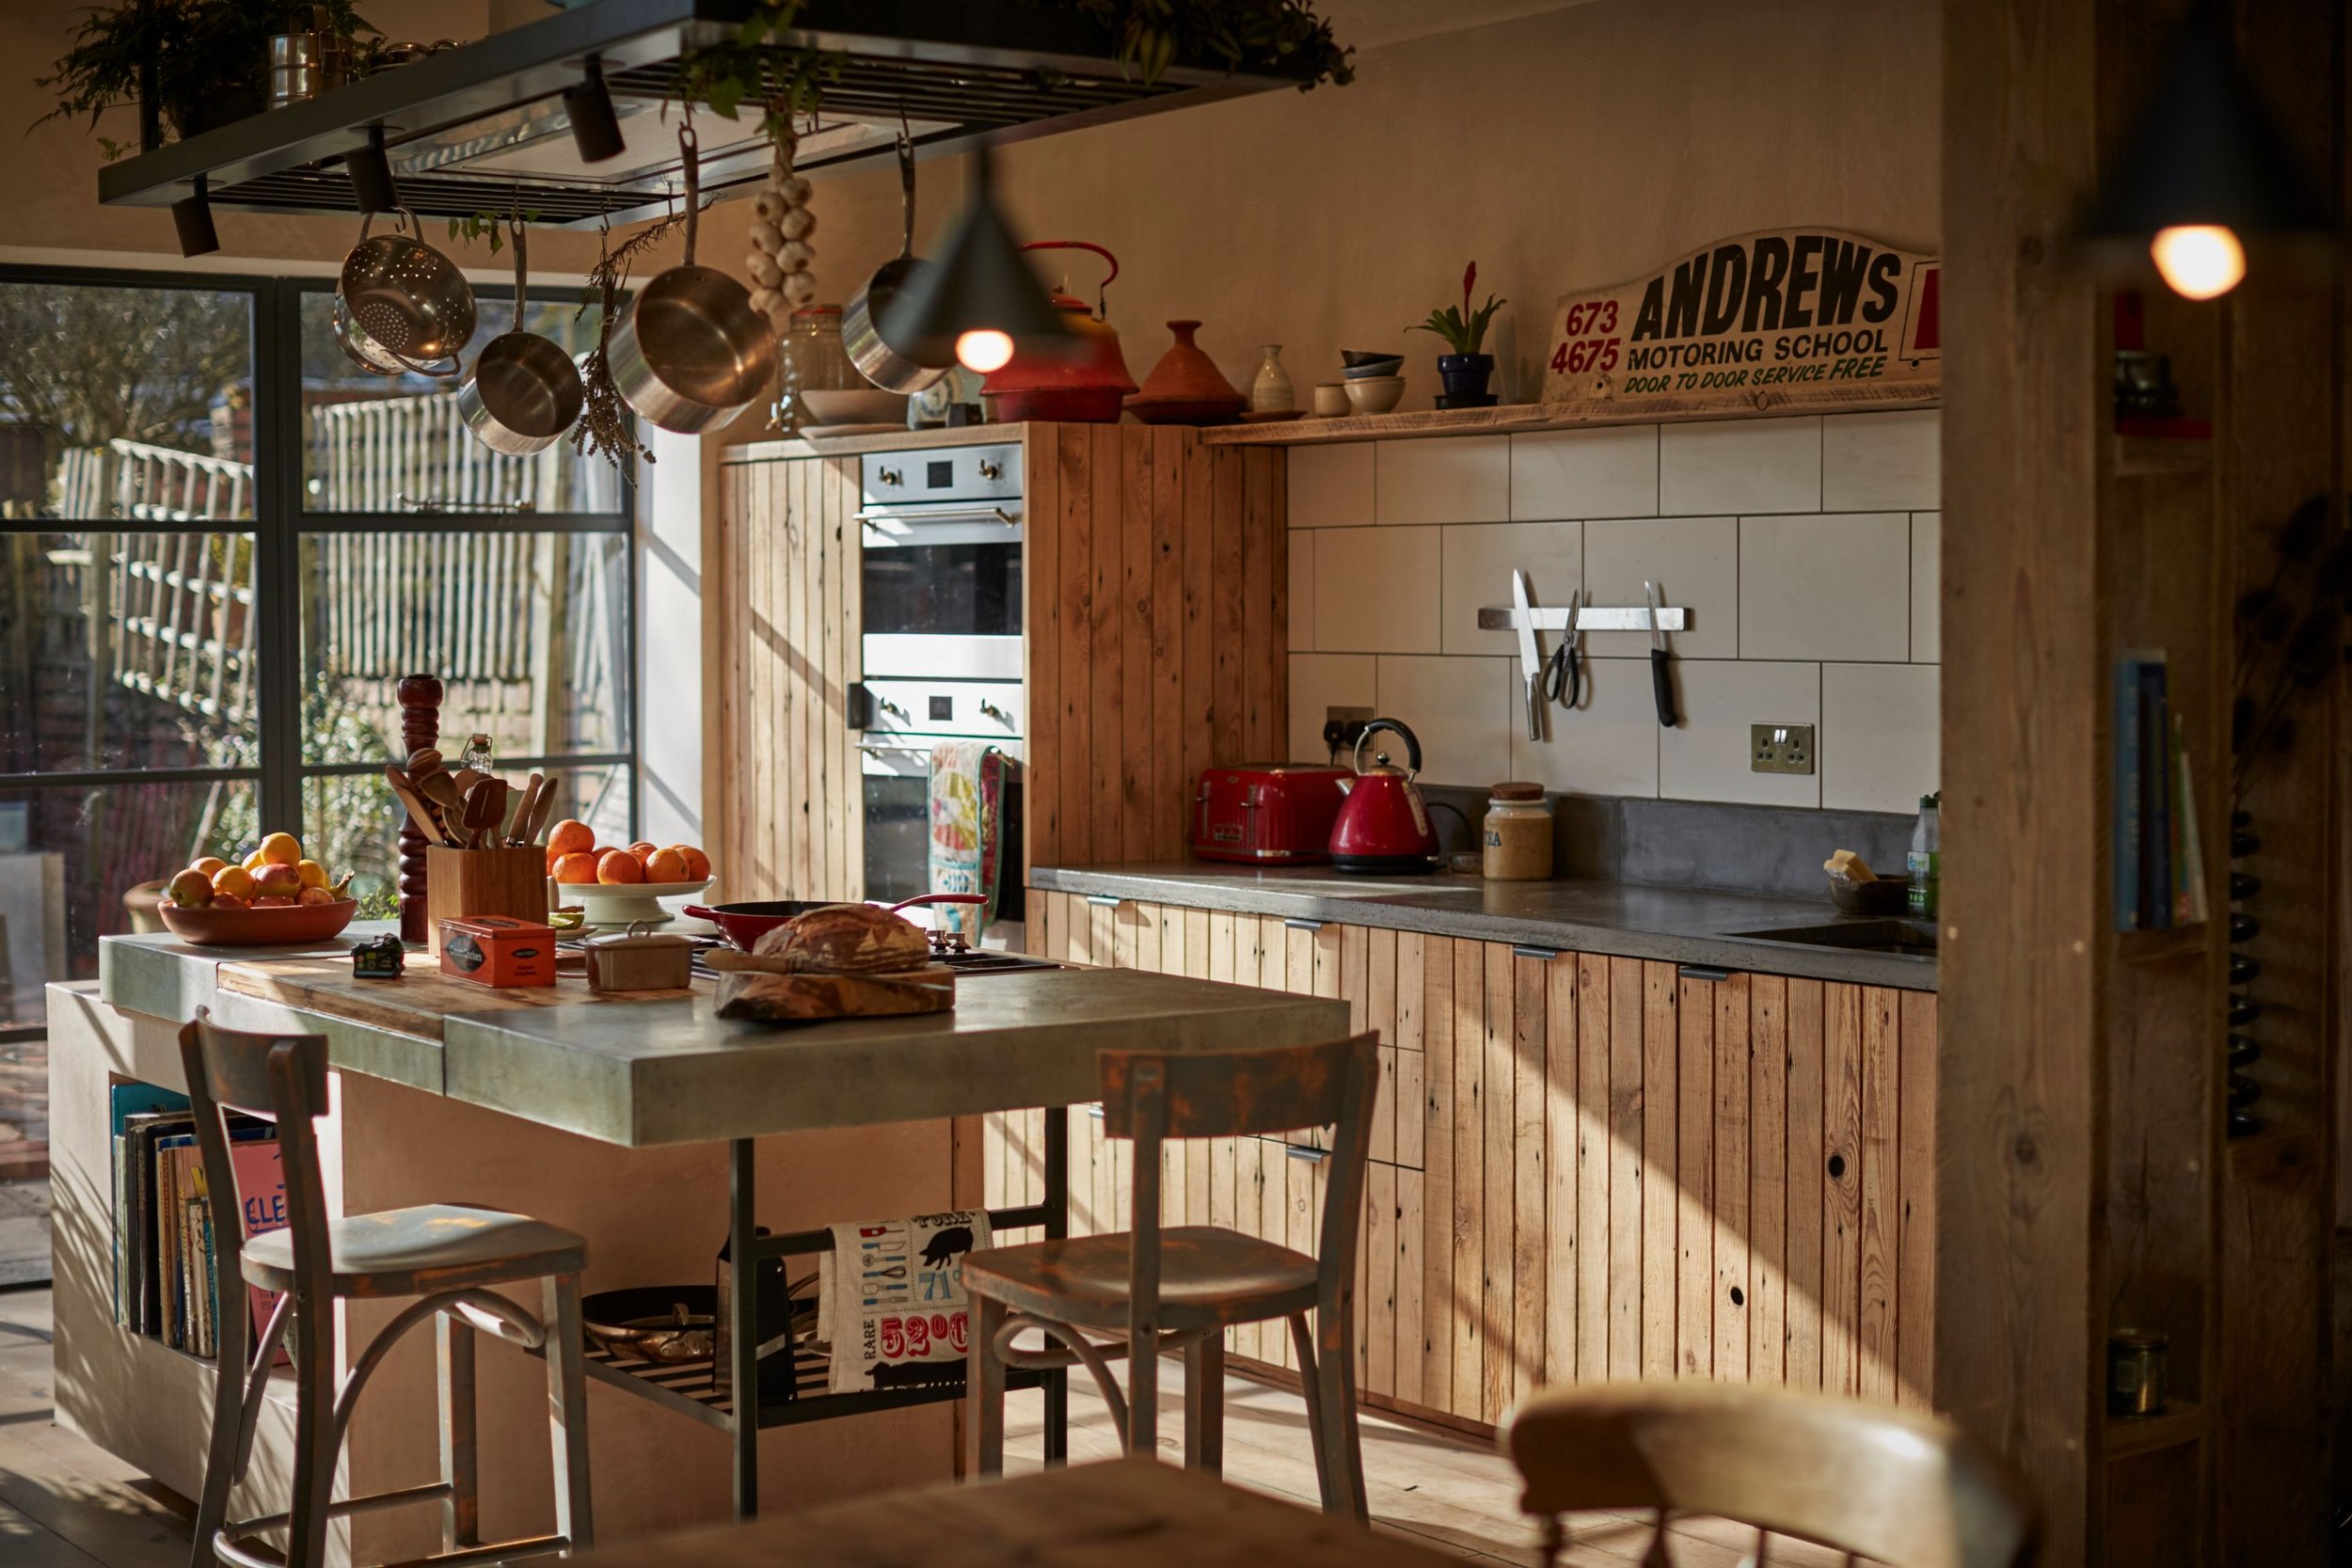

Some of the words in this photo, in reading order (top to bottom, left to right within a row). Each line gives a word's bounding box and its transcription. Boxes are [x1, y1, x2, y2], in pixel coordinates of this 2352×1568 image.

[1630, 235, 1901, 341] ANDREWS
[1566, 300, 1618, 337] 673
[1550, 338, 1621, 374] 4675
[1627, 338, 1764, 371] MOTORING
[1774, 329, 1888, 361] SCHOOL
[1624, 374, 1671, 393] DOOR
[1677, 372, 1698, 390] TO
[1700, 370, 1748, 388] DOOR
[1751, 363, 1827, 386] SERVICE
[1829, 356, 1887, 380] FREE
[1484, 831, 1502, 846] TEA
[863, 1319, 877, 1360] RARE
